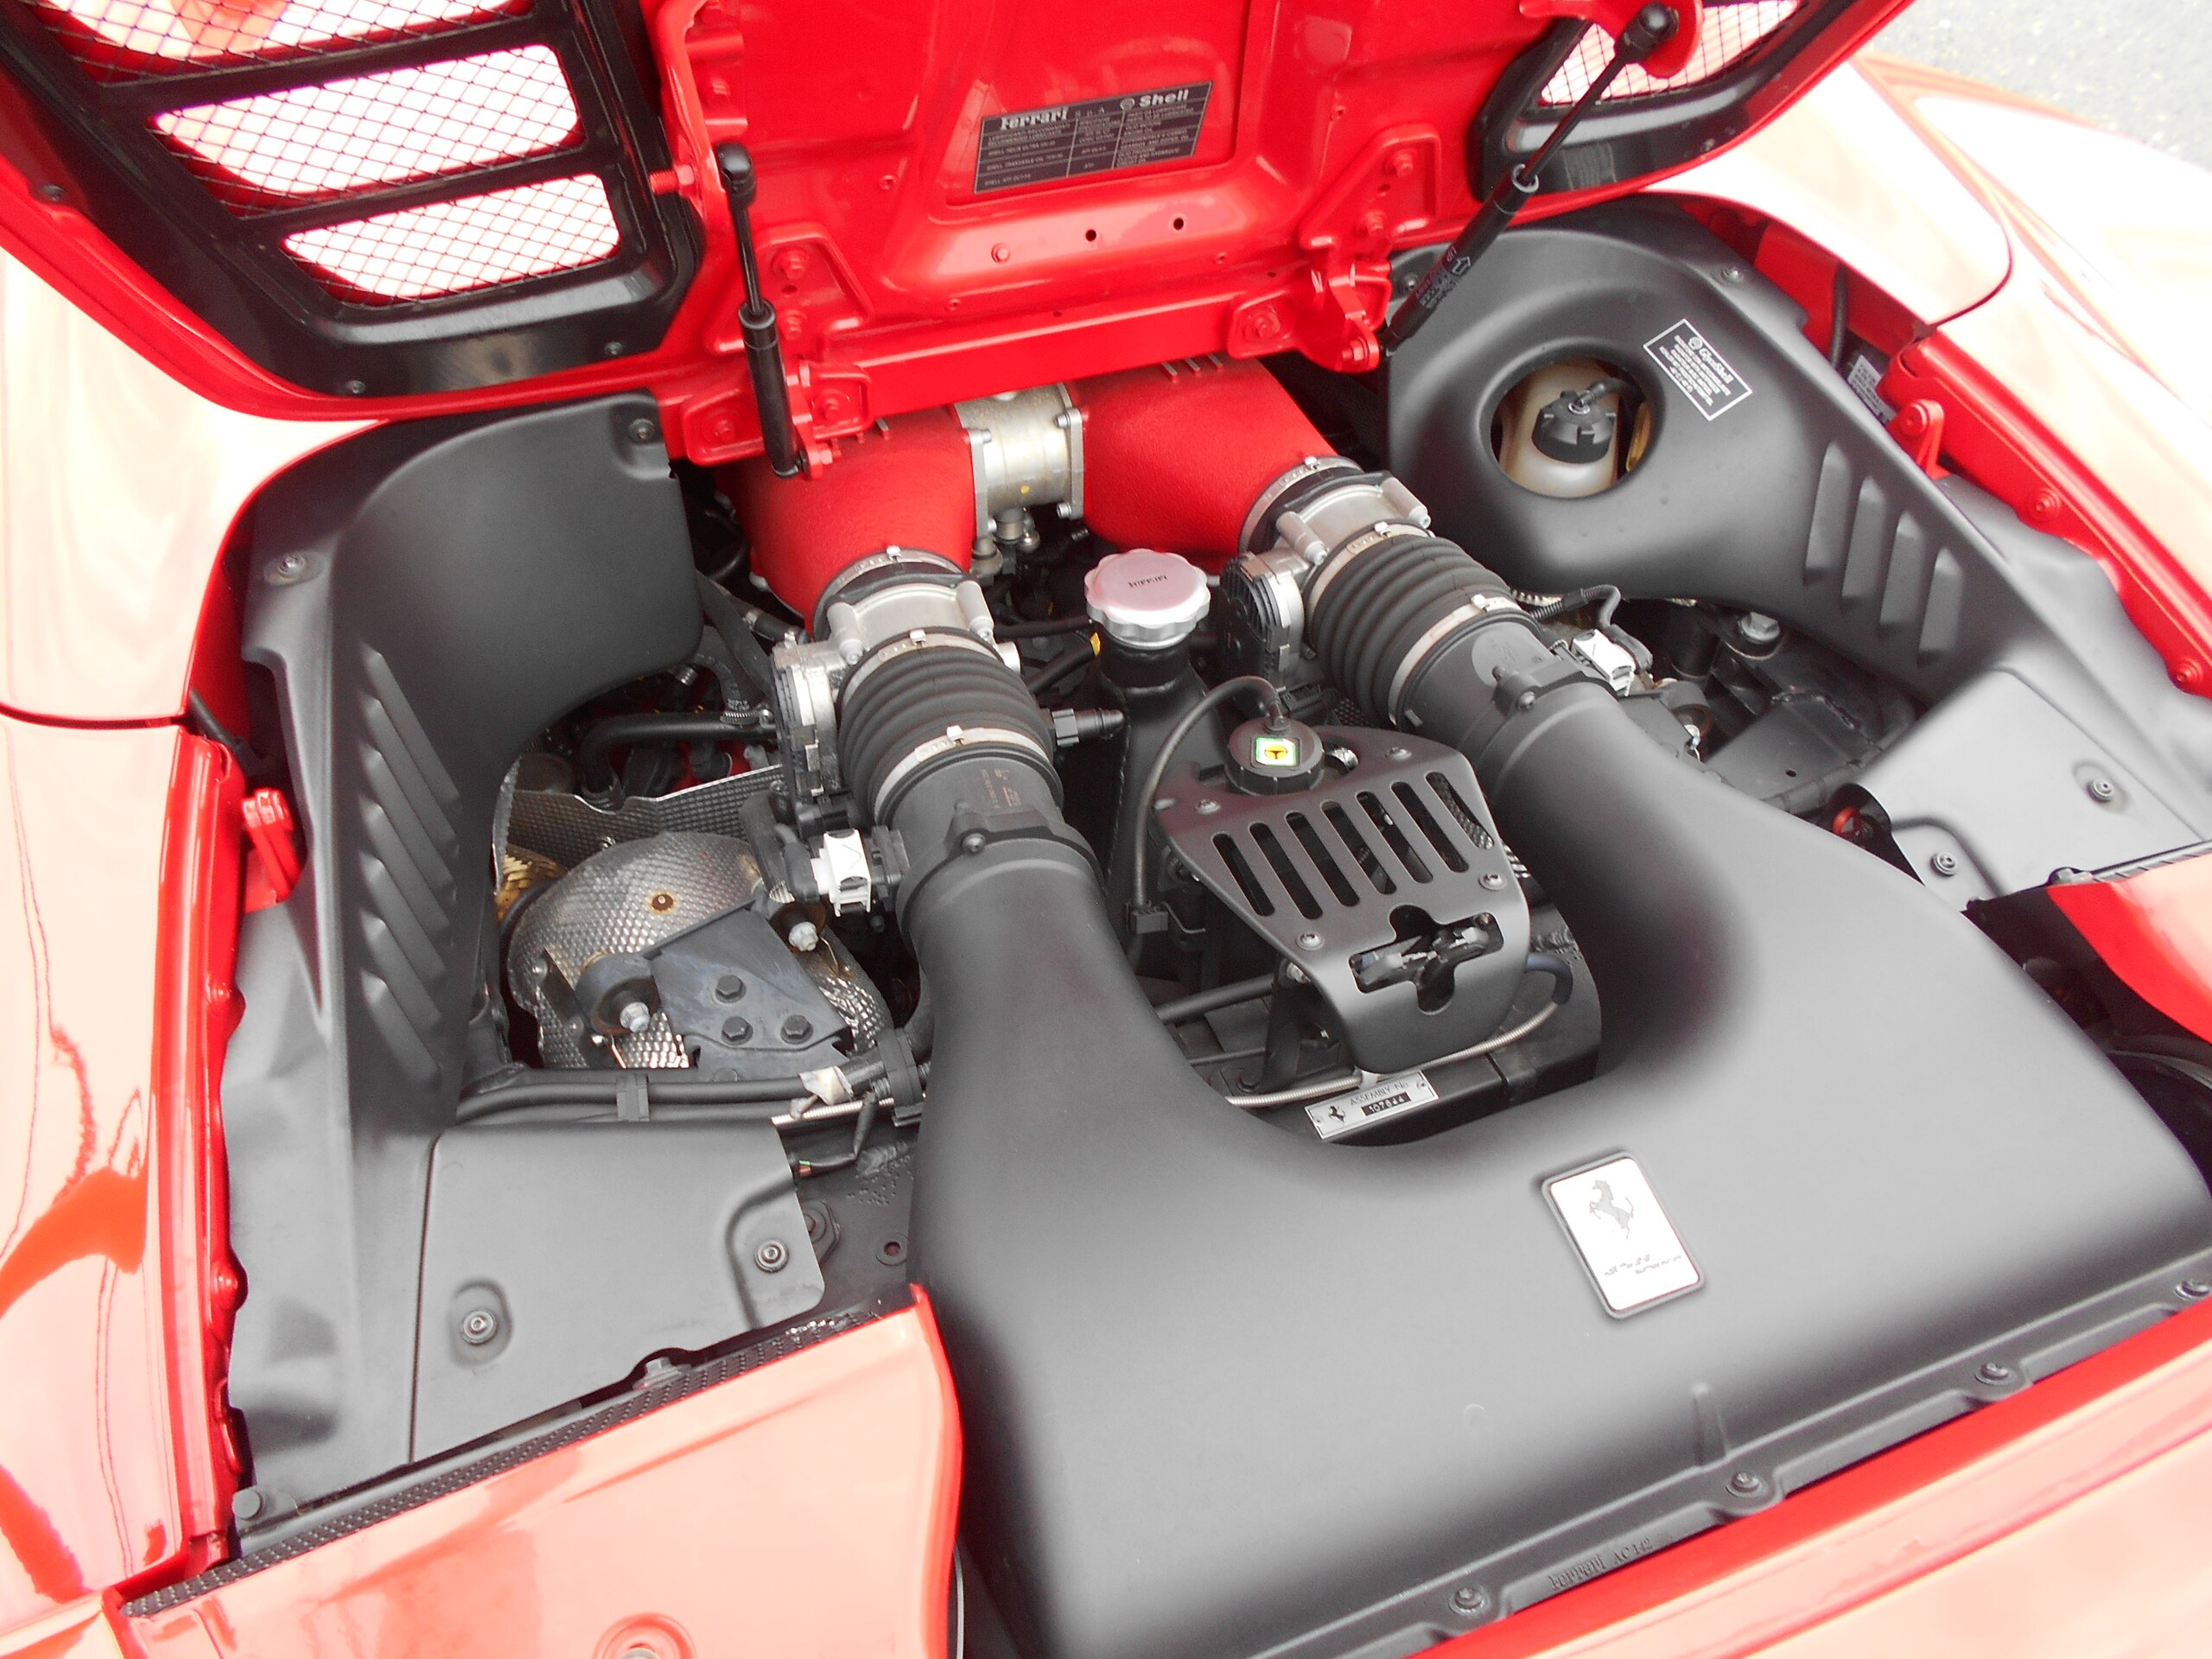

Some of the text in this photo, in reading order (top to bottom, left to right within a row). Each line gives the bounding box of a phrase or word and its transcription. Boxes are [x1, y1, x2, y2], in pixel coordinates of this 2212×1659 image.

[1139, 89, 1189, 108] Shell
[1000, 107, 1070, 130] Ferrari
[1350, 1085, 1391, 1107] ASSEMBLY
[1548, 1554, 1607, 1591] Ferrari
